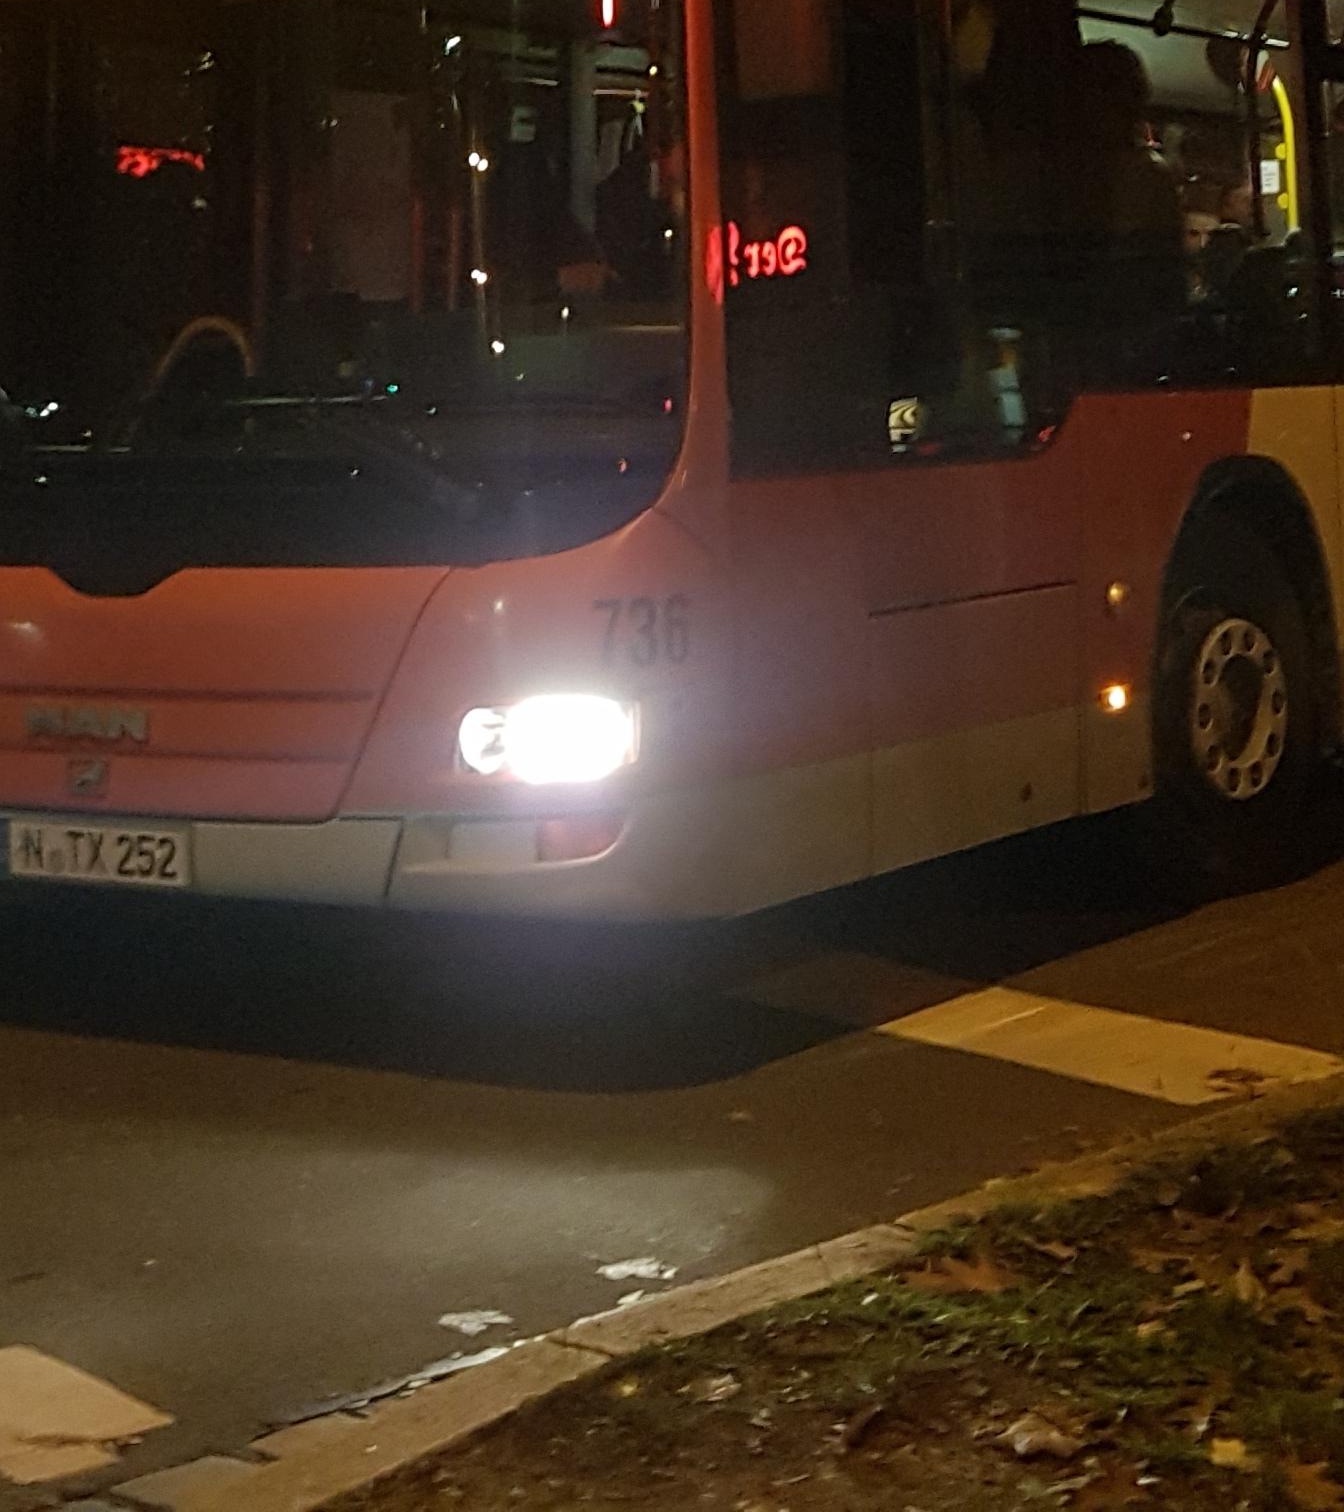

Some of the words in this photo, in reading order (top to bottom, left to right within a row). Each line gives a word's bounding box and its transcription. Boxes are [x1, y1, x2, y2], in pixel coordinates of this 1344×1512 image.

[592, 593, 690, 668] 736
[17, 829, 45, 869] N
[67, 831, 105, 876] TX
[115, 836, 178, 880] 252
